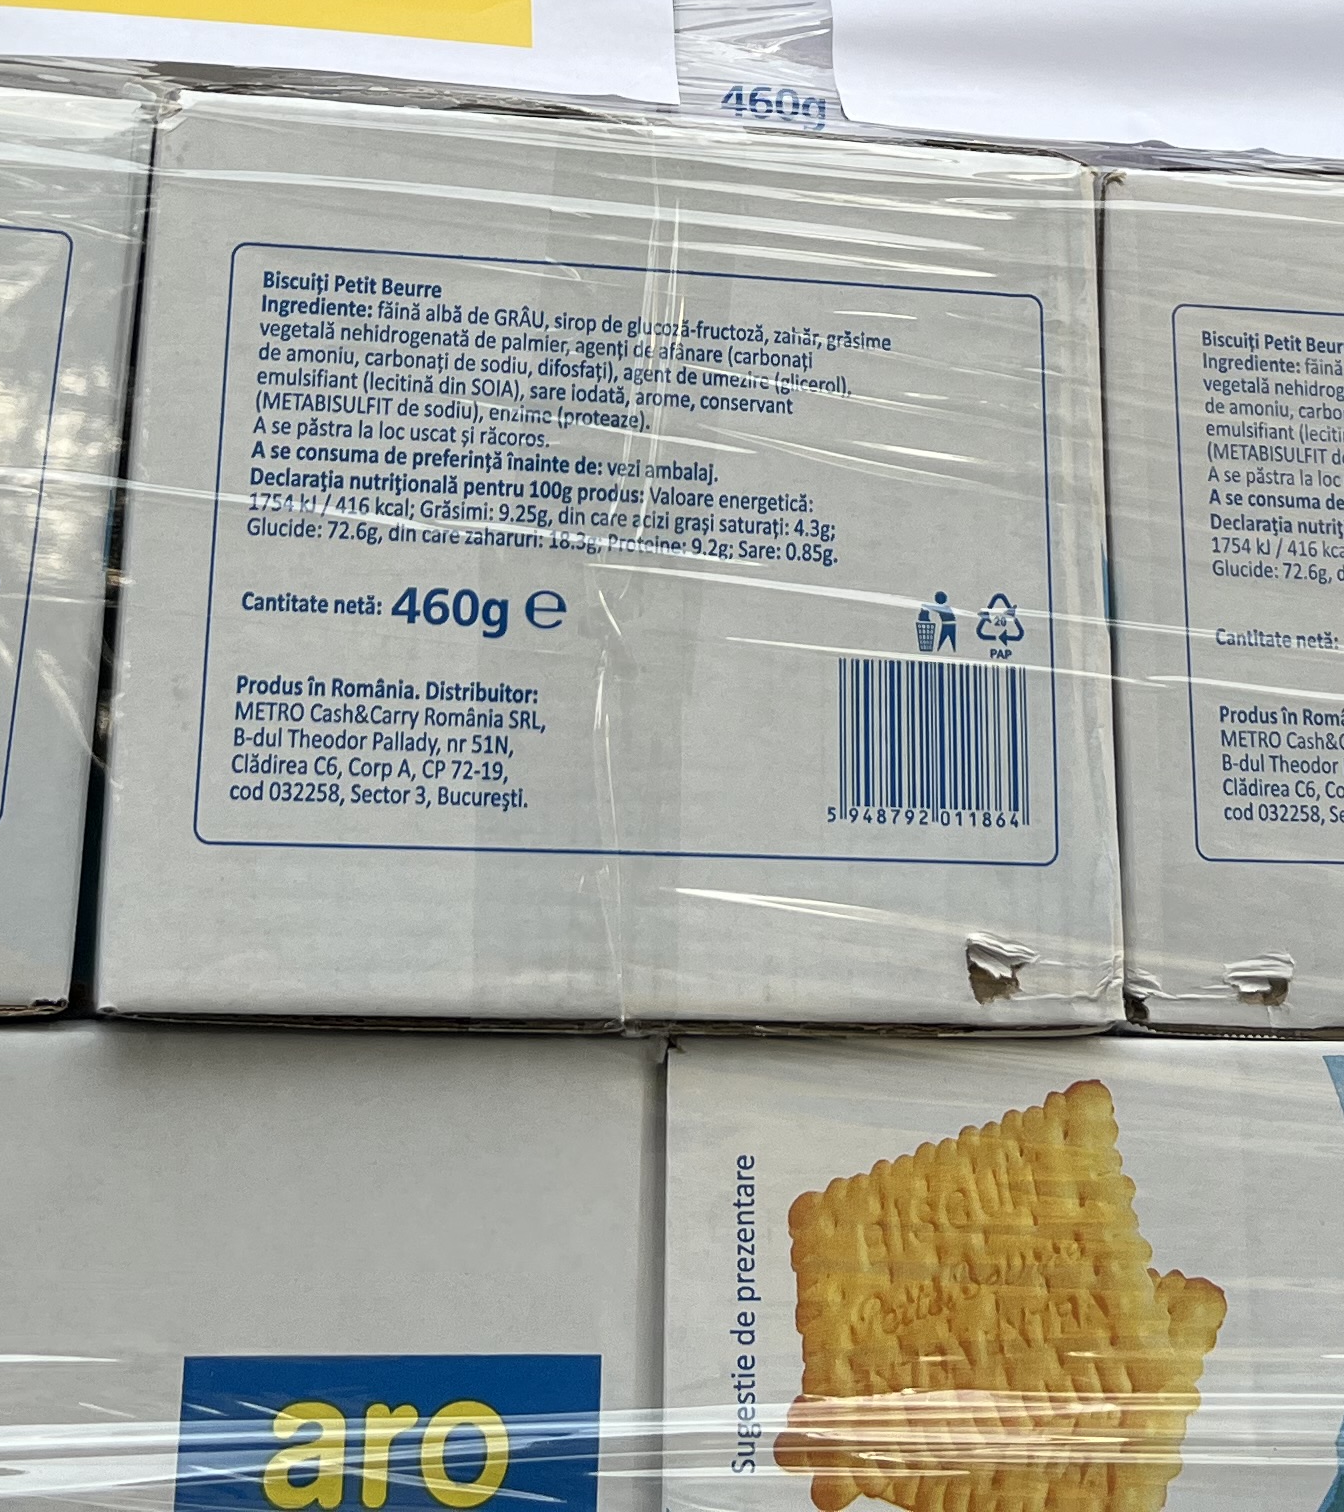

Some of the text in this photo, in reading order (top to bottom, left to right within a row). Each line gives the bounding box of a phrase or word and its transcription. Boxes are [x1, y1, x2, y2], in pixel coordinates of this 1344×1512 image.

[720, 84, 828, 131] 460g
[264, 271, 441, 298] Biscuiți Petit Beurre
[262, 294, 372, 318] Ingrediente:
[378, 301, 420, 320] făină
[426, 304, 461, 323] albă
[468, 306, 489, 325] de
[495, 306, 549, 331] GRÂU,
[554, 312, 596, 335] sirop
[602, 314, 622, 333] de
[827, 330, 891, 351] grăsime
[1202, 331, 1259, 352] Biscuiți
[1265, 334, 1301, 352] Petit
[257, 368, 793, 414] emulsifiant (lecitină din SOIA), sare iodată, arome, conservant
[253, 416, 549, 448] A se păstra la loc uscat și răcoros.
[1213, 560, 1278, 578] Glucide:
[1283, 563, 1332, 584] 72.6g,
[241, 591, 329, 614] Cantitate
[333, 593, 383, 615] netă:
[392, 587, 509, 638] 460g
[990, 648, 1012, 660] PAP
[1215, 628, 1291, 648] Cantitate
[1296, 632, 1340, 650] netă:
[237, 675, 537, 704] Produs în România. Distribuitor:
[235, 701, 545, 734] METRO Cash&Carry România SRL,
[1220, 706, 1277, 724] Produs
[1281, 706, 1297, 725] în
[234, 727, 513, 758] B-dul Theodor Pallady, nr 51N,
[1221, 730, 1281, 748] METRO
[232, 753, 508, 785] Clădirea C6, Corp A, CP 72-19,
[827, 806, 1019, 828] 5 948792 011864
[729, 1152, 762, 1475] Sugestie de prezentare
[262, 1399, 510, 1510] aro
